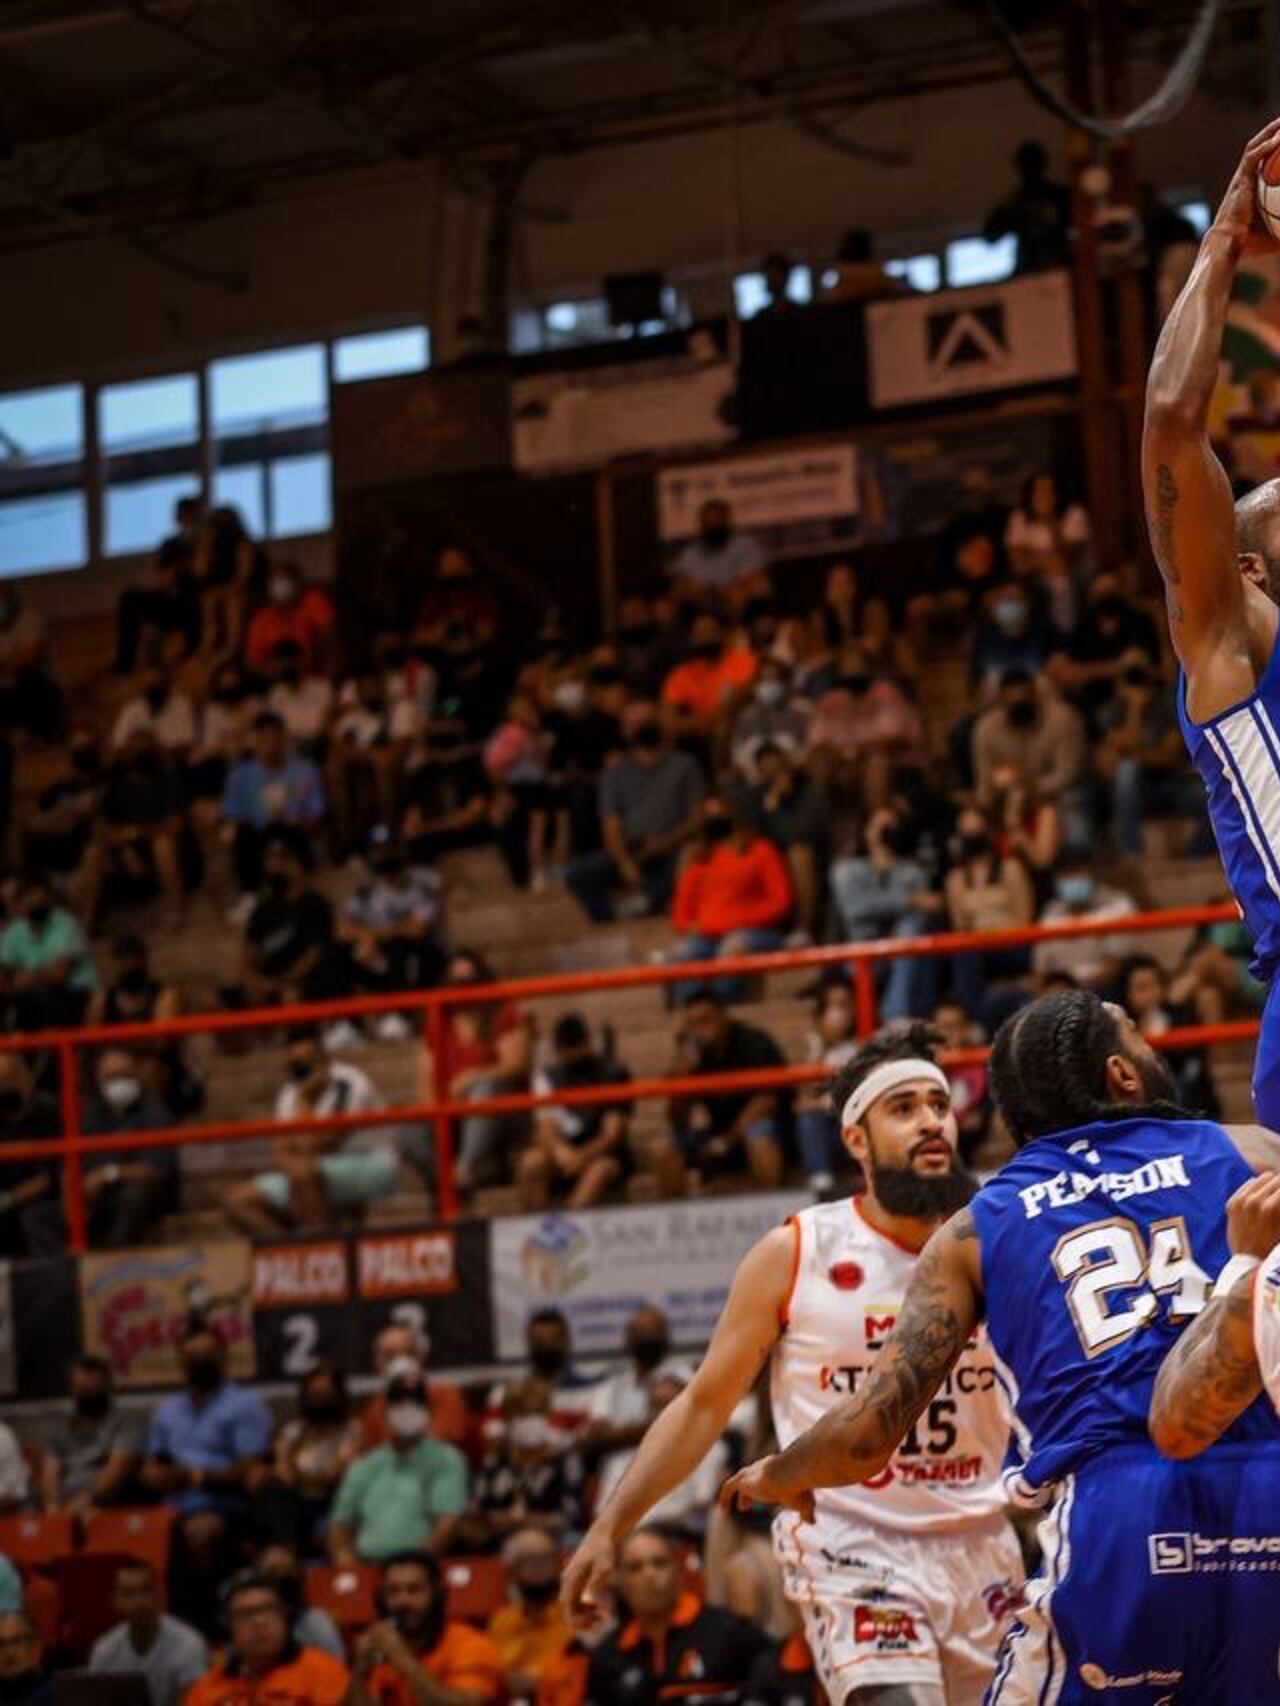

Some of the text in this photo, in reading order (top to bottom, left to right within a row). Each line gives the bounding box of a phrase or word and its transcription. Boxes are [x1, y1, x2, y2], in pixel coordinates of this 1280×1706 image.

[1018, 1155, 1191, 1220] PEASON
[257, 1252, 347, 1303] PALCO
[360, 1237, 451, 1284] PALCO
[1052, 1216, 1216, 1361] 24
[281, 1314, 320, 1374] 2
